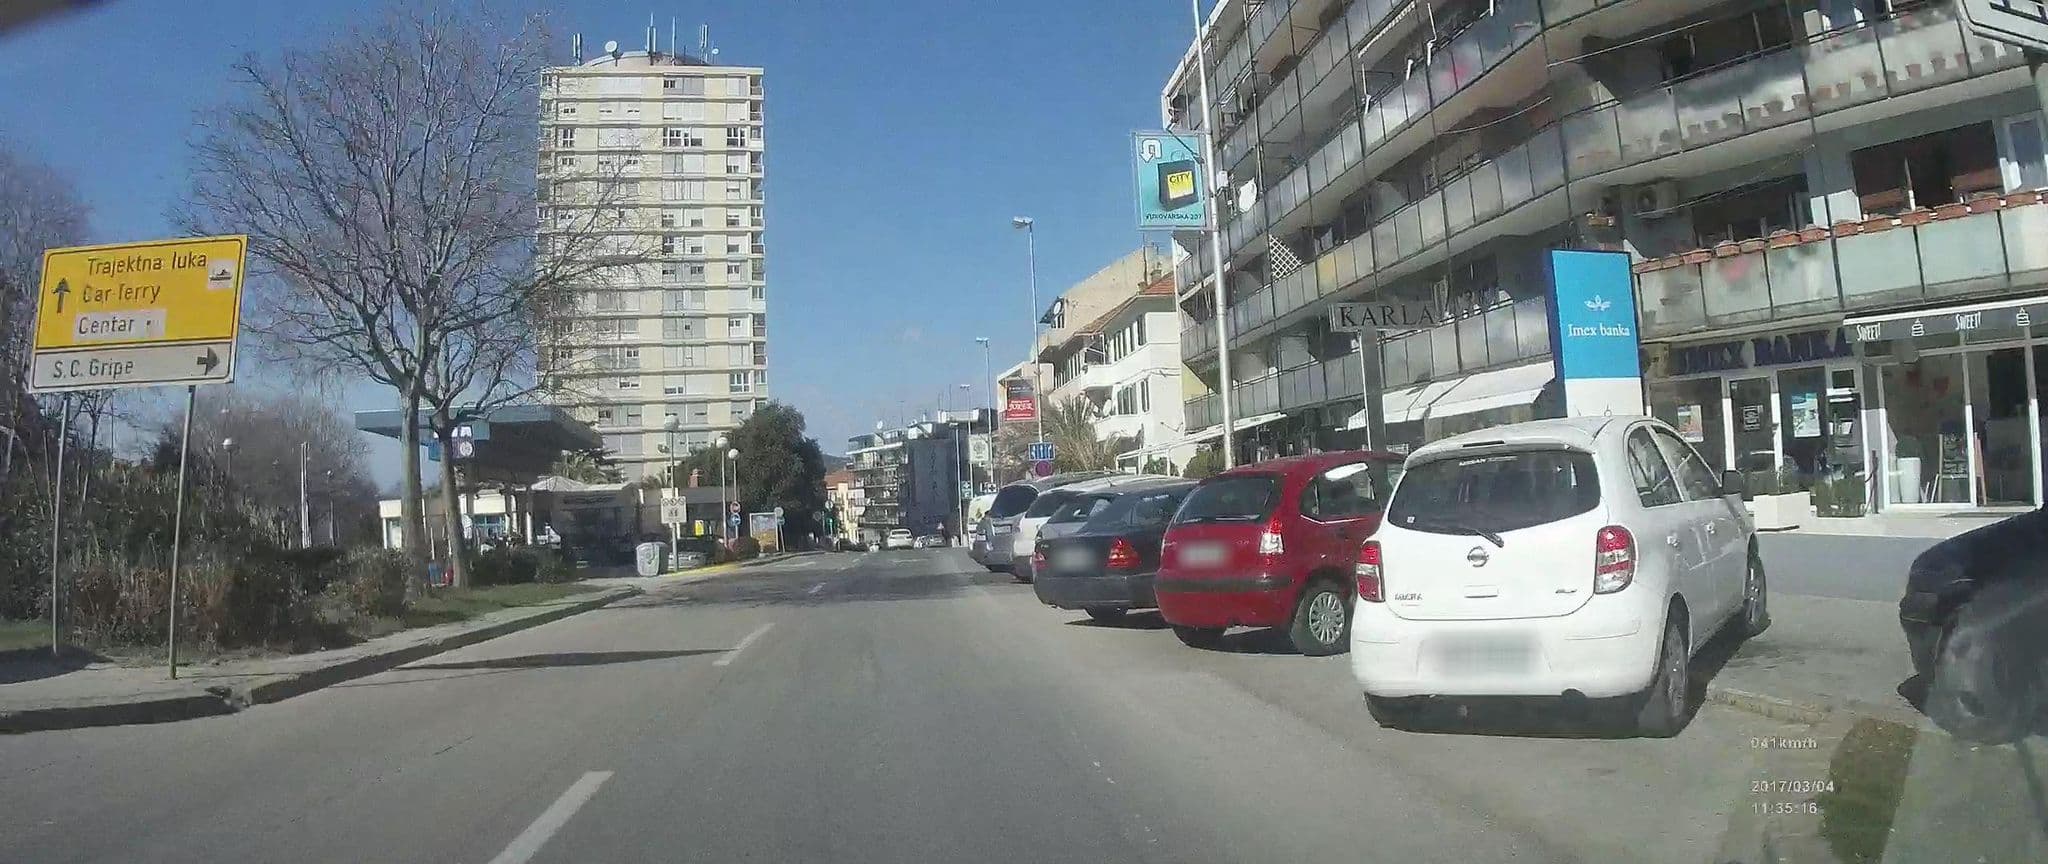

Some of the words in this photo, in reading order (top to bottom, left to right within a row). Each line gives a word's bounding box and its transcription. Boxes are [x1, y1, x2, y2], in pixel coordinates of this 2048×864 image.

[1169, 172, 1190, 183] CITY
[88, 254, 163, 278] Trajektna
[171, 251, 207, 271] luka
[1338, 303, 1436, 327] KARLA
[78, 316, 135, 335] Centar
[1567, 323, 1597, 337] Imex
[1599, 322, 1631, 337] banka
[53, 360, 84, 379] S.C.
[89, 359, 134, 377] Gripe
